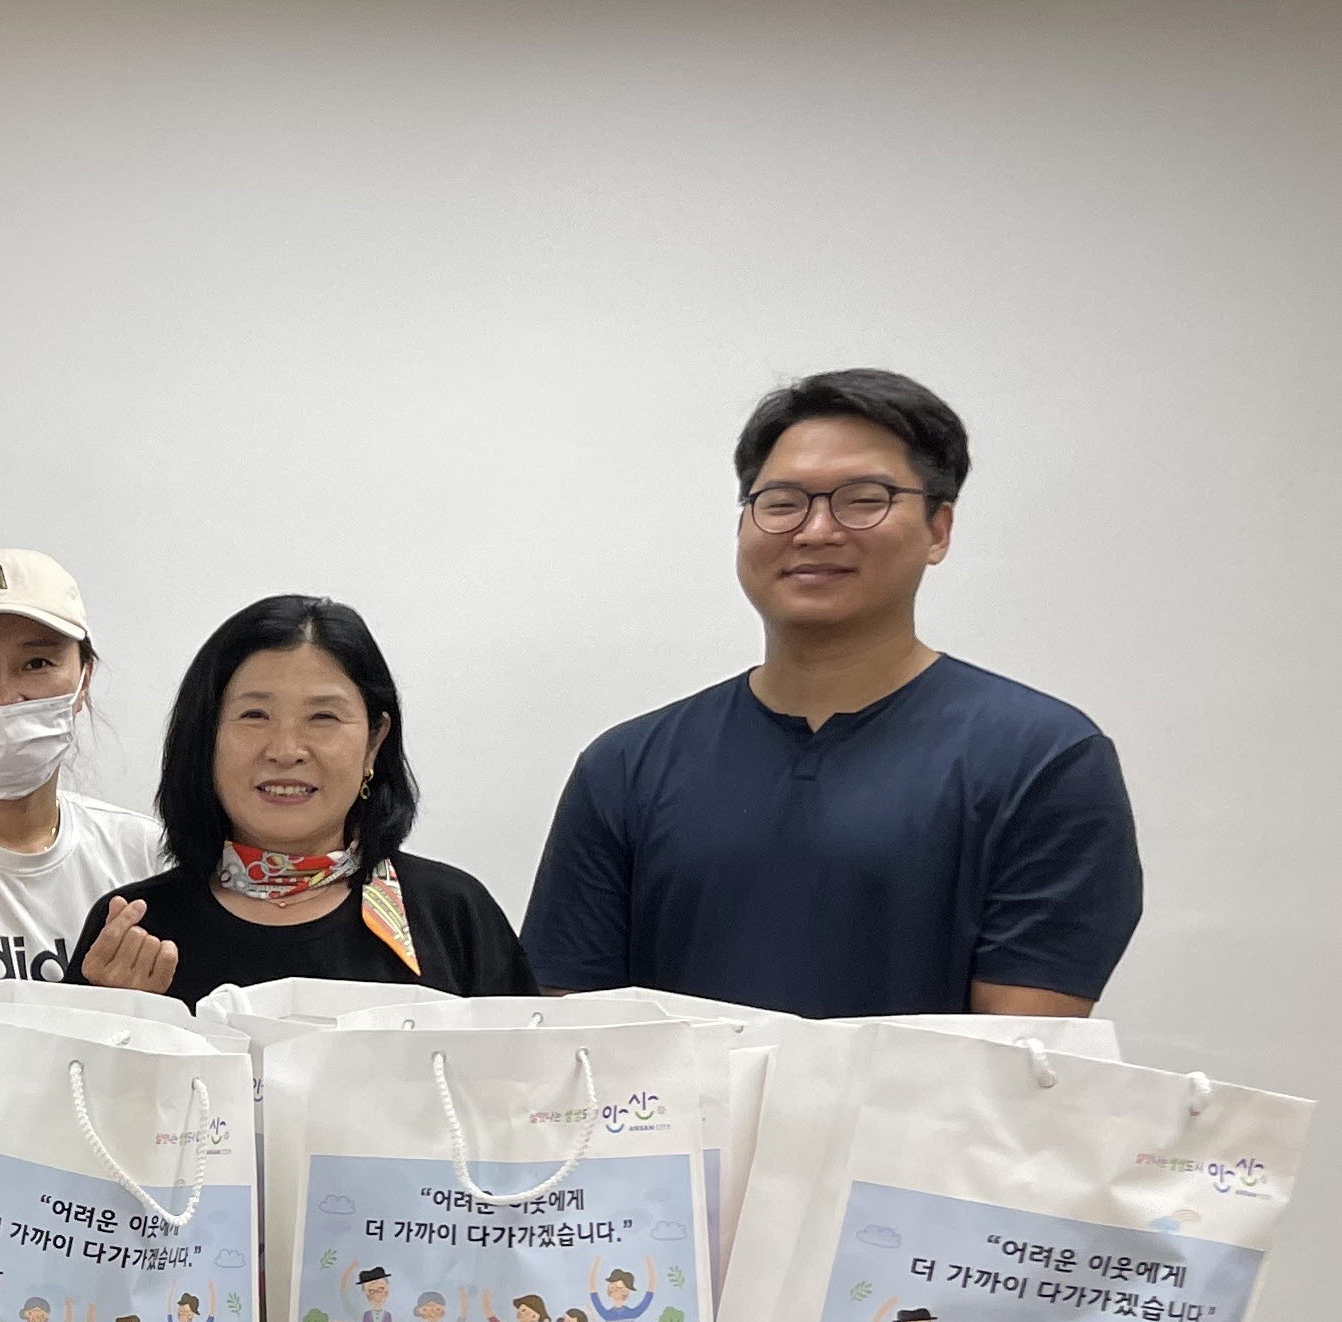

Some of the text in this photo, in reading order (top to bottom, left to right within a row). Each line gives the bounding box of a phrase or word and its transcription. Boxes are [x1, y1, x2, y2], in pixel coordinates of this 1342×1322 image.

[10, 1221, 74, 1258] 가까이
[365, 1219, 384, 1242] 더
[394, 1221, 457, 1246] 가까이
[911, 1257, 935, 1282] 더
[948, 1264, 1026, 1299] 가까이
[1089, 1254, 1187, 1288] 이웃에게
